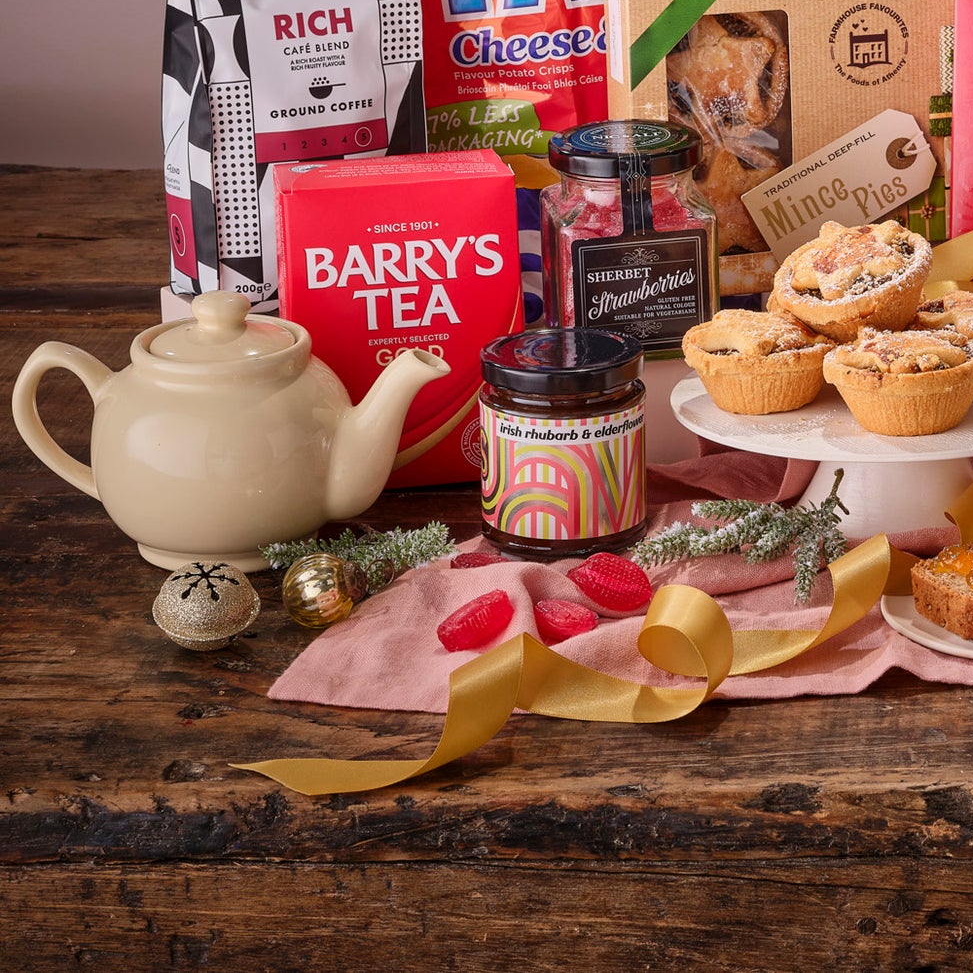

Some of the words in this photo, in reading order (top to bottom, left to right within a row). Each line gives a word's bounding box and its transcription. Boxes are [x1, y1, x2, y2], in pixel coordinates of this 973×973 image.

[273, 7, 354, 41] RICH
[828, 3, 868, 44] FARMHOUSE
[869, 2, 909, 40] FAVOURITES
[283, 43, 311, 56] CAFÉ
[315, 40, 350, 53] BLEND
[450, 26, 595, 67] Cheese
[291, 64, 304, 72] RICH
[304, 62, 321, 70] FRUITY
[322, 60, 346, 69] FLAVOUR
[310, 56, 326, 64] ROAST
[326, 55, 340, 63] WITH
[454, 71, 495, 81] Flavour
[498, 68, 535, 78] Potato
[538, 64, 575, 76] Crisps
[532, 81, 551, 90] Faoi
[554, 78, 577, 89] Bhlas
[579, 74, 604, 85] Cáise
[834, 63, 847, 77] The
[846, 74, 870, 87] Foods
[871, 78, 881, 87] of
[881, 58, 906, 83] Athenry
[270, 104, 326, 119] GROUND
[330, 98, 373, 113] COFFEE
[468, 104, 525, 126] LESS
[281, 142, 287, 152] 1
[301, 140, 308, 150] 2
[321, 137, 328, 148] 3
[341, 135, 348, 145] 4
[360, 131, 368, 143] 5
[763, 159, 828, 198] TRADITIONAL
[827, 131, 876, 161] DEEP-FILL
[759, 178, 849, 241] Mince
[850, 176, 908, 219] Pies
[374, 223, 407, 233] SINCE
[409, 221, 433, 231] 1901
[304, 234, 504, 290] BARRY'S
[587, 266, 652, 284] SHERBET
[235, 284, 263, 294] 200g
[588, 268, 697, 321] Strawberries
[352, 284, 461, 331] TEA
[644, 303, 672, 312] NATURAL
[672, 302, 696, 310] COLOUR
[657, 296, 680, 304] GLUTEN
[614, 312, 642, 321] SUITABLE
[656, 308, 697, 317] VEGETARIANS
[368, 336, 407, 346] EXPERTLY
[409, 333, 450, 343] SELECTED
[500, 422, 522, 439] irish
[525, 427, 578, 441] rhubarb
[582, 429, 592, 439] &
[594, 414, 644, 438] elderflower
